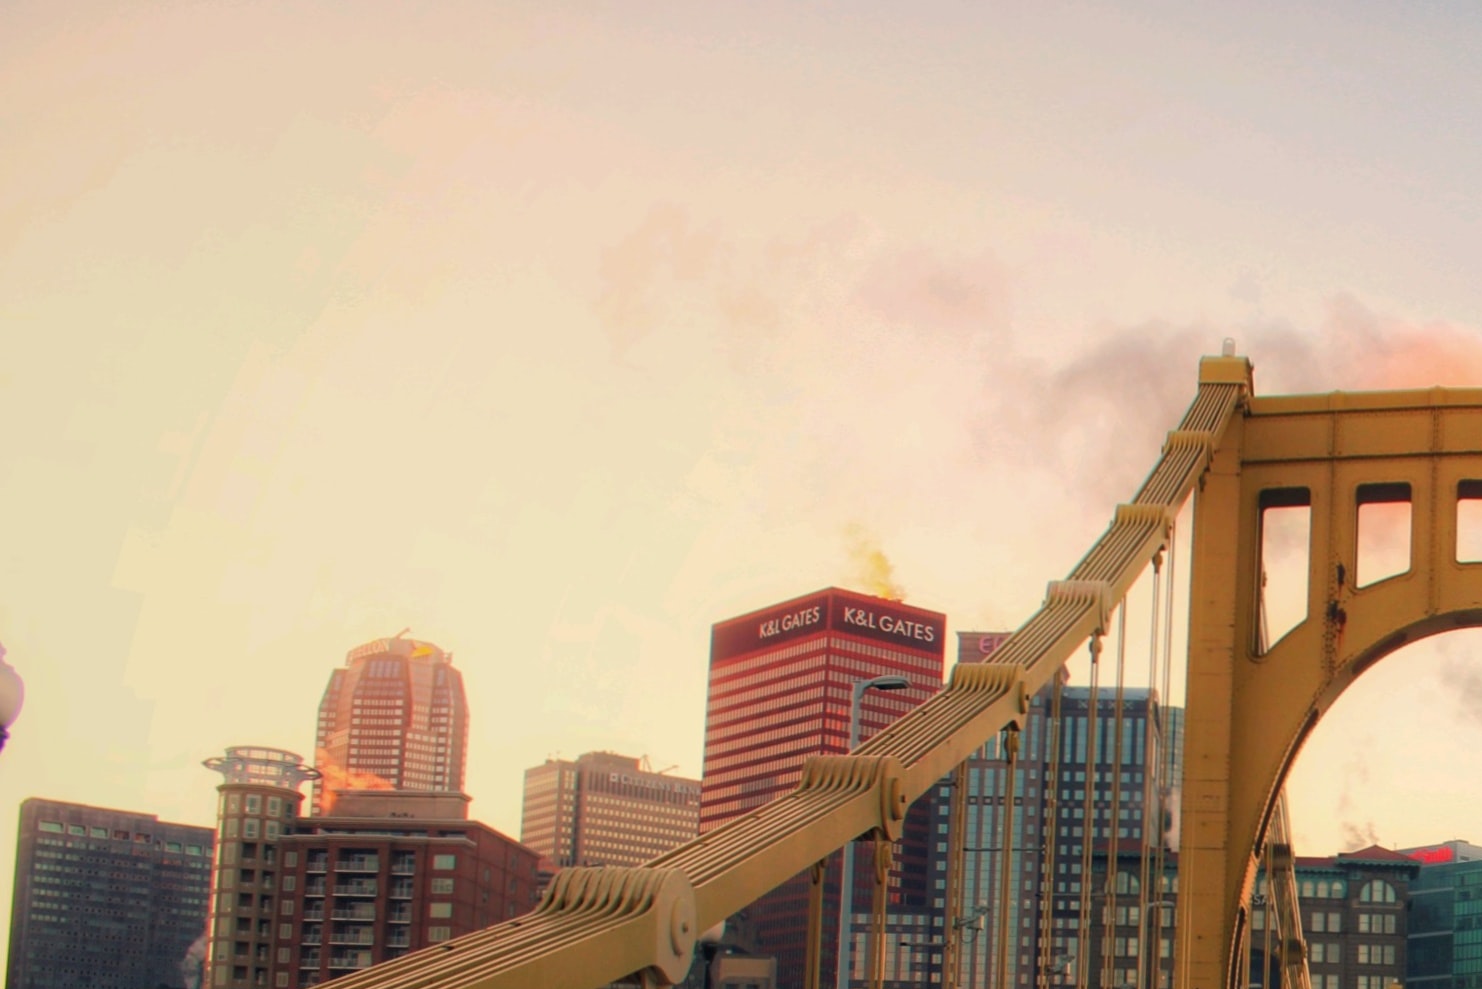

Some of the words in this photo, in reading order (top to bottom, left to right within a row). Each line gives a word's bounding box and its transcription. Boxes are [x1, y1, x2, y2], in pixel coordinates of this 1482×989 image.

[759, 619, 781, 639] K&L
[782, 606, 820, 632] GATES
[844, 607, 876, 629] K&L
[879, 615, 935, 642] GATES
